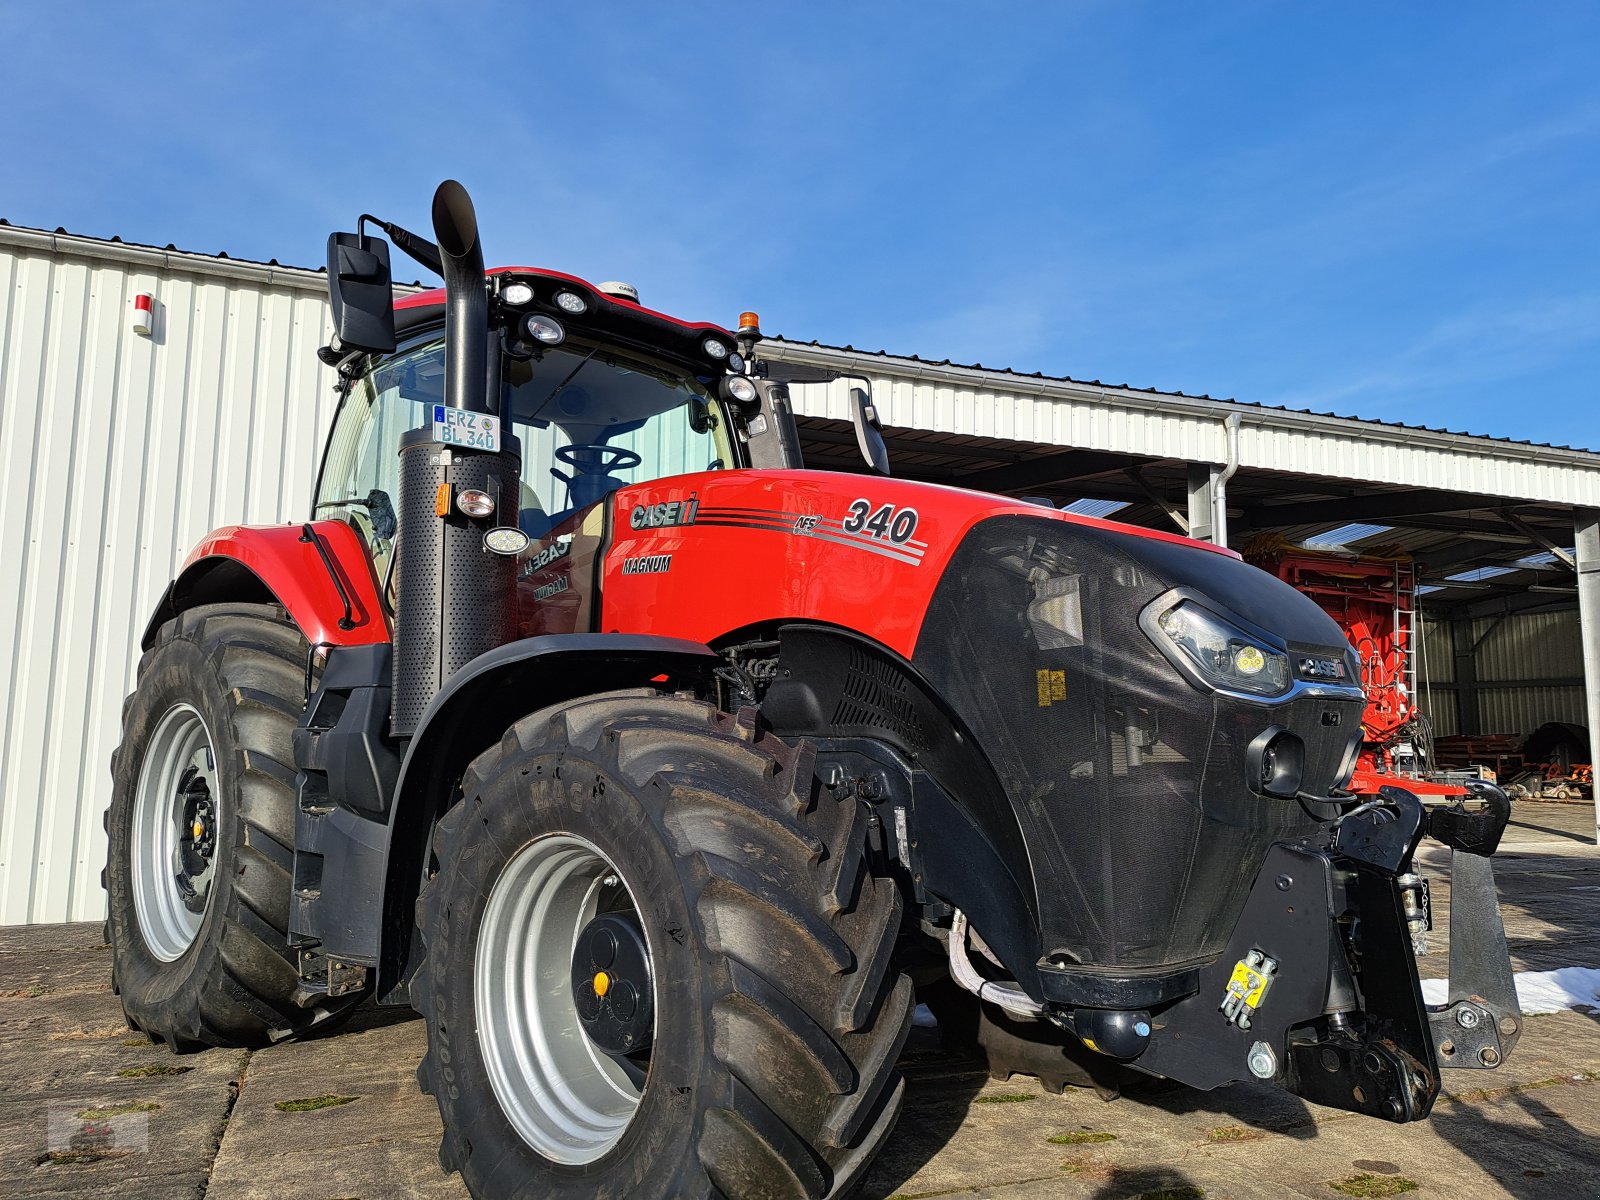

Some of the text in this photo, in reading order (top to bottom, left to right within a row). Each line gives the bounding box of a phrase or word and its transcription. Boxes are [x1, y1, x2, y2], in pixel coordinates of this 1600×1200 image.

[446, 409, 477, 429] ERZ
[442, 425, 495, 449] BL 340
[794, 514, 817, 531] AFS
[842, 498, 919, 546] 340
[622, 554, 672, 575] MAGNUM
